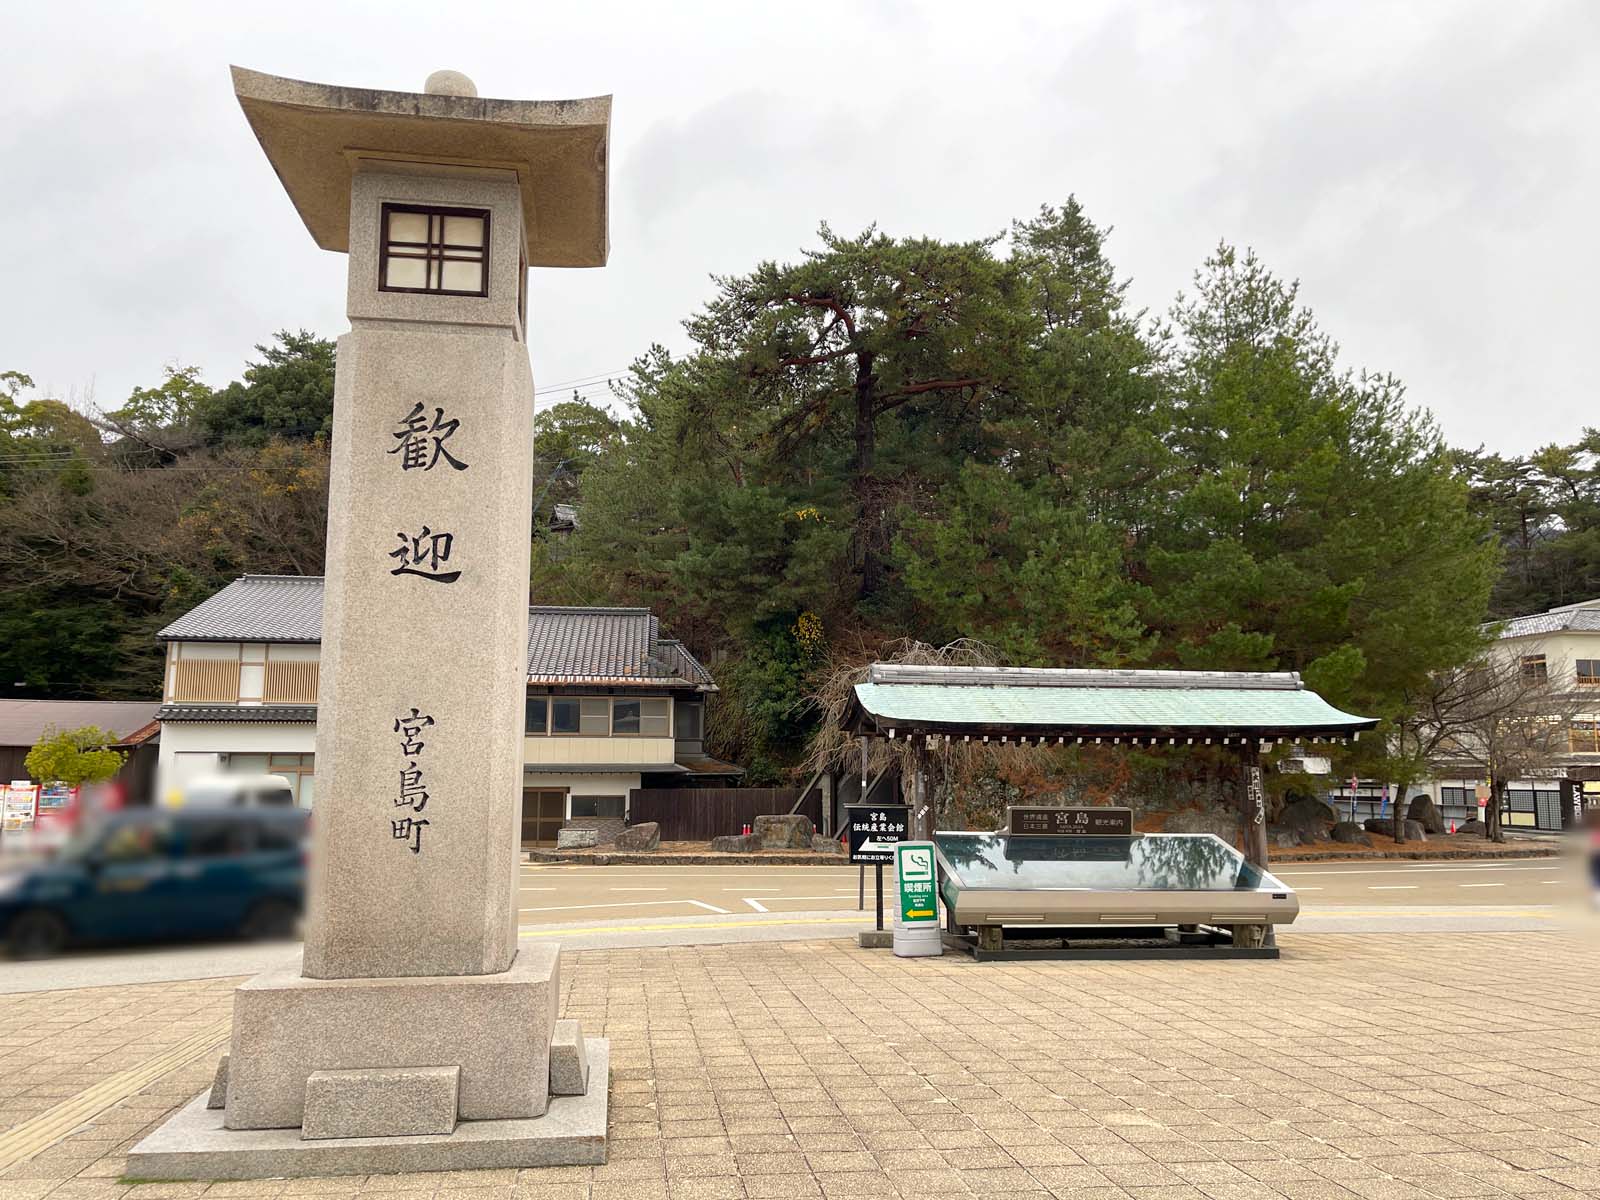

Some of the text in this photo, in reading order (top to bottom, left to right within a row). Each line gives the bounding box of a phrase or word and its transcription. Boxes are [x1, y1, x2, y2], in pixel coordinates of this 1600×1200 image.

[391, 708, 435, 854] 宮島町
[869, 812, 887, 821] 宮島
[1055, 812, 1089, 824] 宮島
[853, 822, 904, 832] 伝統産業会館
[904, 882, 932, 893] 喫煙所
